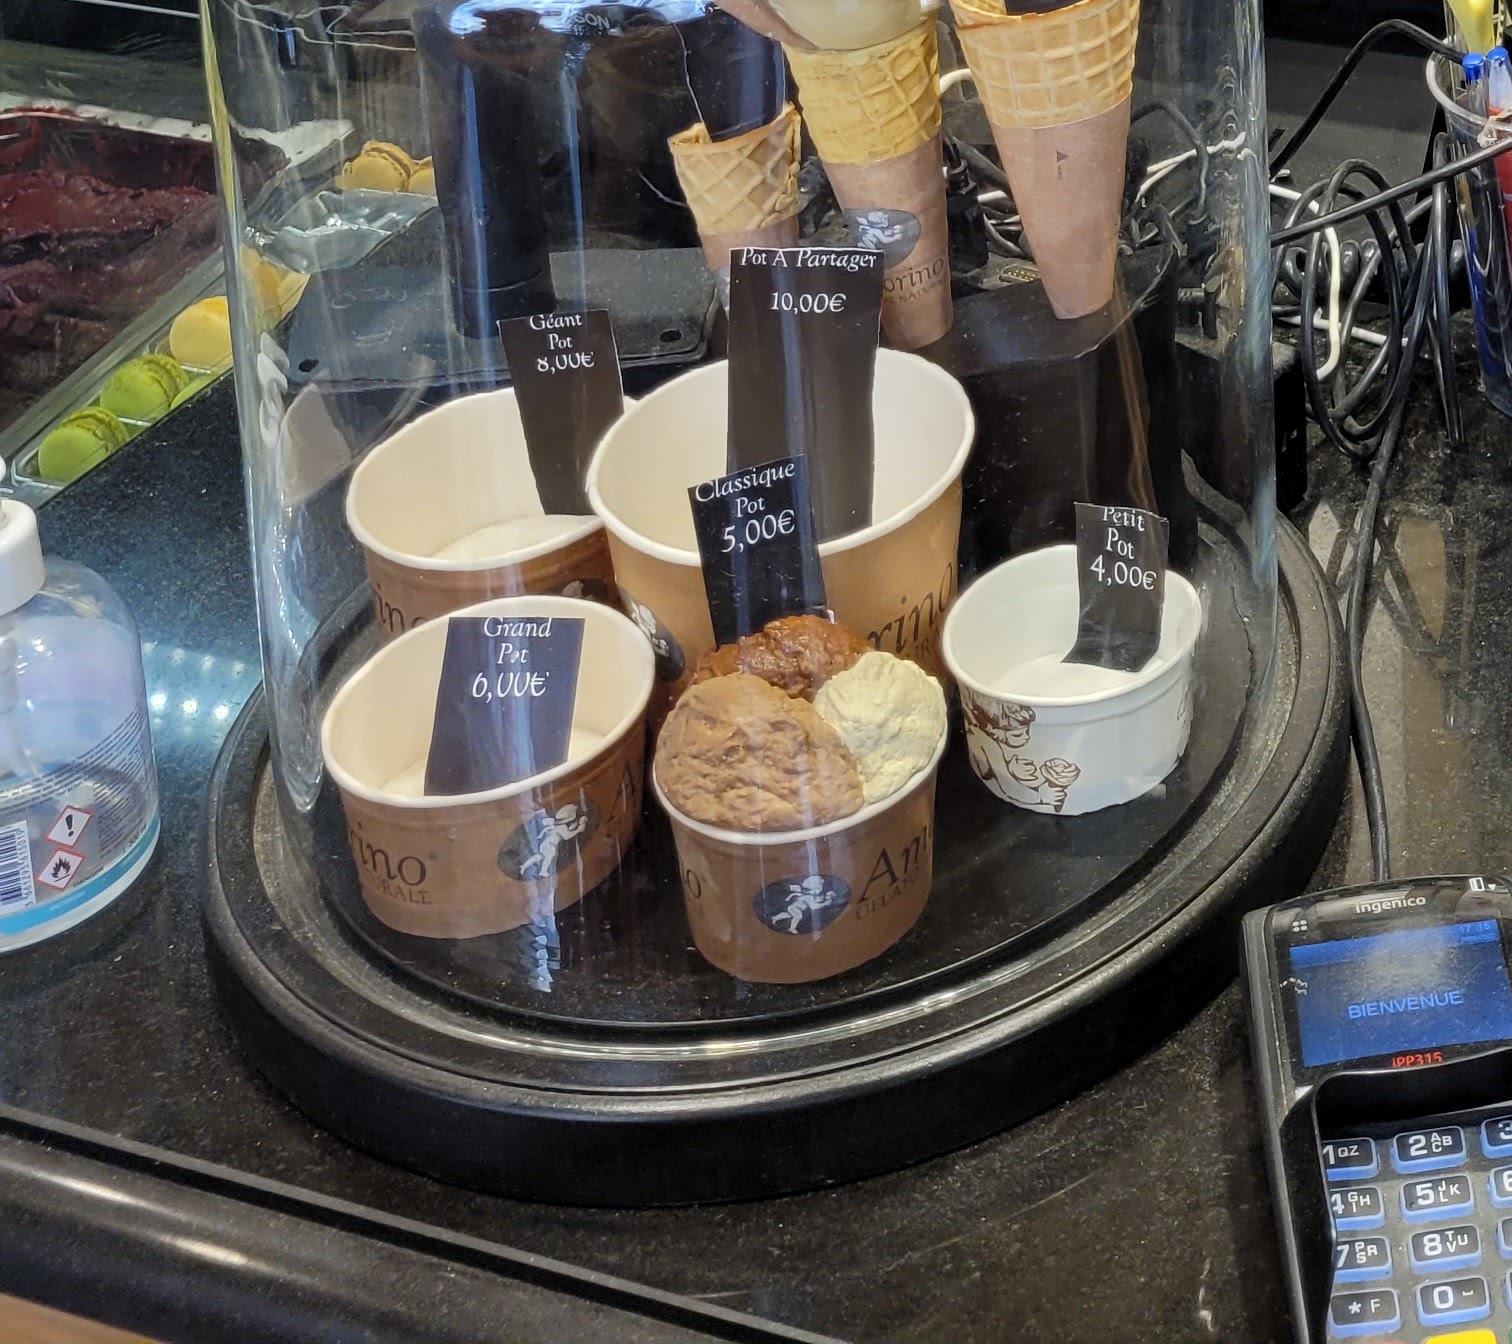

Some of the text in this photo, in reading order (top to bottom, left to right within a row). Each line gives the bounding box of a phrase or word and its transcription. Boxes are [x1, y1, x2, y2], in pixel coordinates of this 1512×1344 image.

[740, 248, 767, 266] Pot
[795, 248, 877, 272] Partager
[884, 258, 945, 291] orino
[771, 292, 846, 314] 10,00€
[530, 314, 582, 330] Géant
[549, 333, 573, 350] Pot
[695, 462, 796, 502] Classique
[735, 496, 765, 518] Pot
[1102, 507, 1145, 531] Petit
[721, 510, 795, 553] 5,00€
[1105, 527, 1134, 559] Pot
[1090, 555, 1156, 590] 4,00€
[484, 617, 552, 638] Grand
[1356, 896, 1426, 913] ingenico
[1348, 991, 1464, 1019] BIENVENUE
[1408, 1135, 1427, 1156] 2
[1416, 1183, 1434, 1205] 5
[1423, 1233, 1442, 1256] 8
[1433, 1285, 1453, 1309] 0
